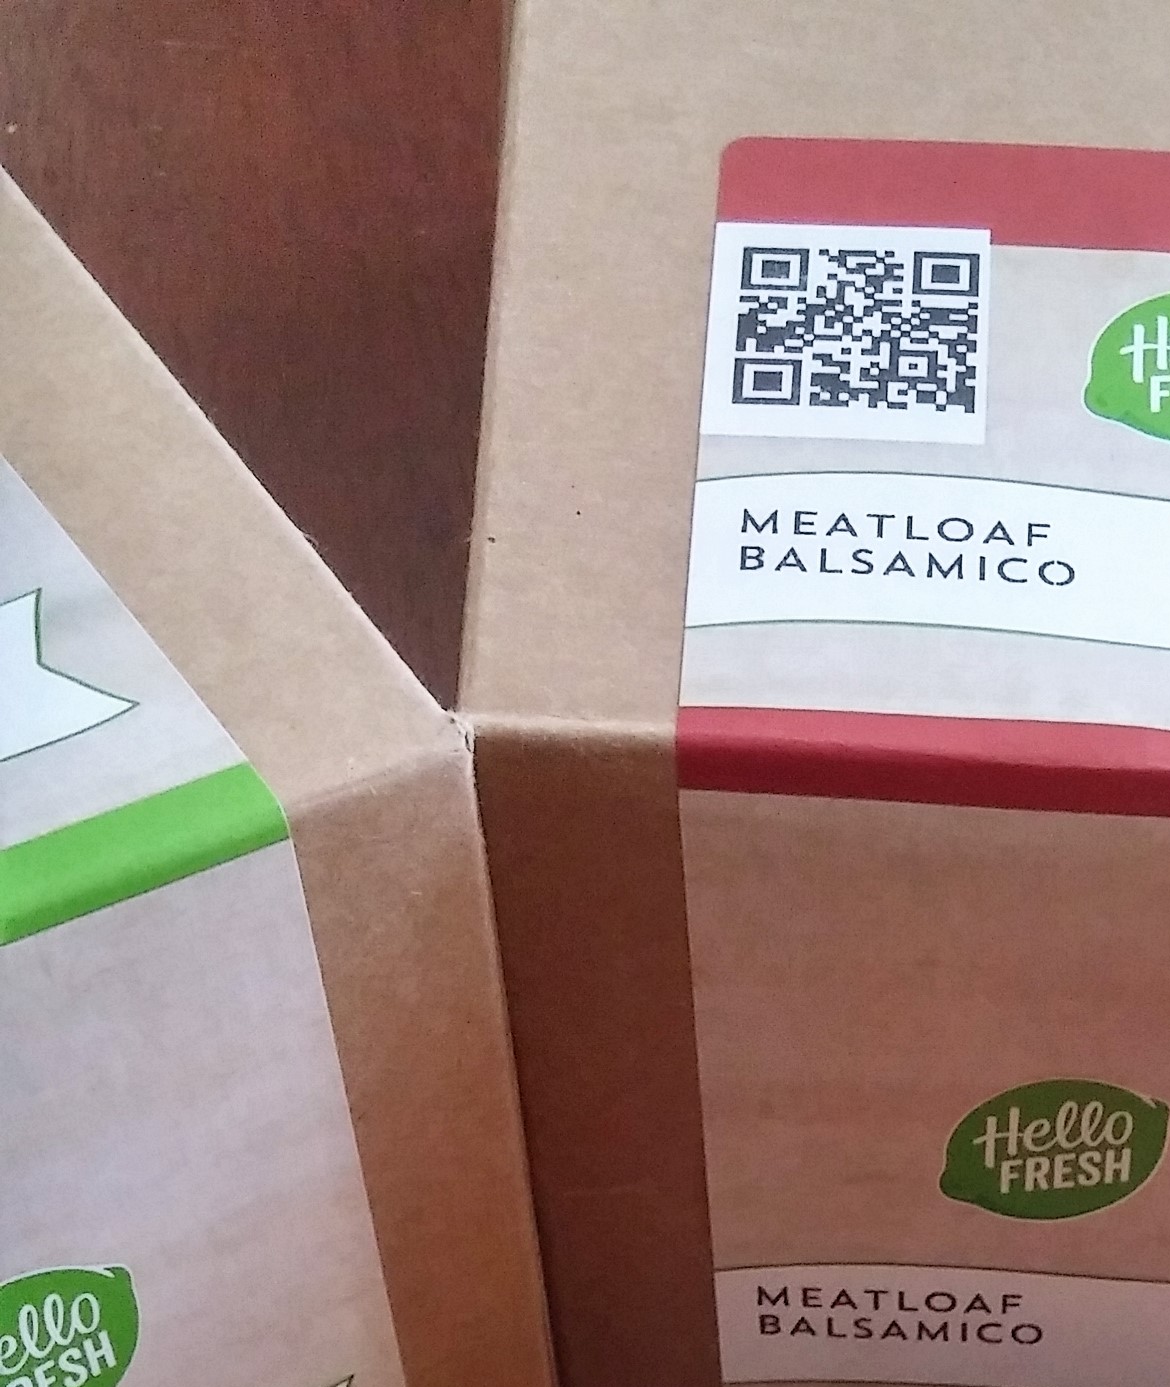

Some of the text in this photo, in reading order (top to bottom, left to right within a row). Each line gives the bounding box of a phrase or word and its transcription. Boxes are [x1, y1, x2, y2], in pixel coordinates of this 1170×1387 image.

[740, 508, 1051, 547] MEATLOAF
[739, 545, 1076, 588] BALSAMICO
[972, 1100, 1134, 1169] Hello
[1000, 1147, 1132, 1194] FRESH
[757, 1285, 1023, 1315] MEATLOAF
[758, 1314, 1044, 1346] BALSAMICO
